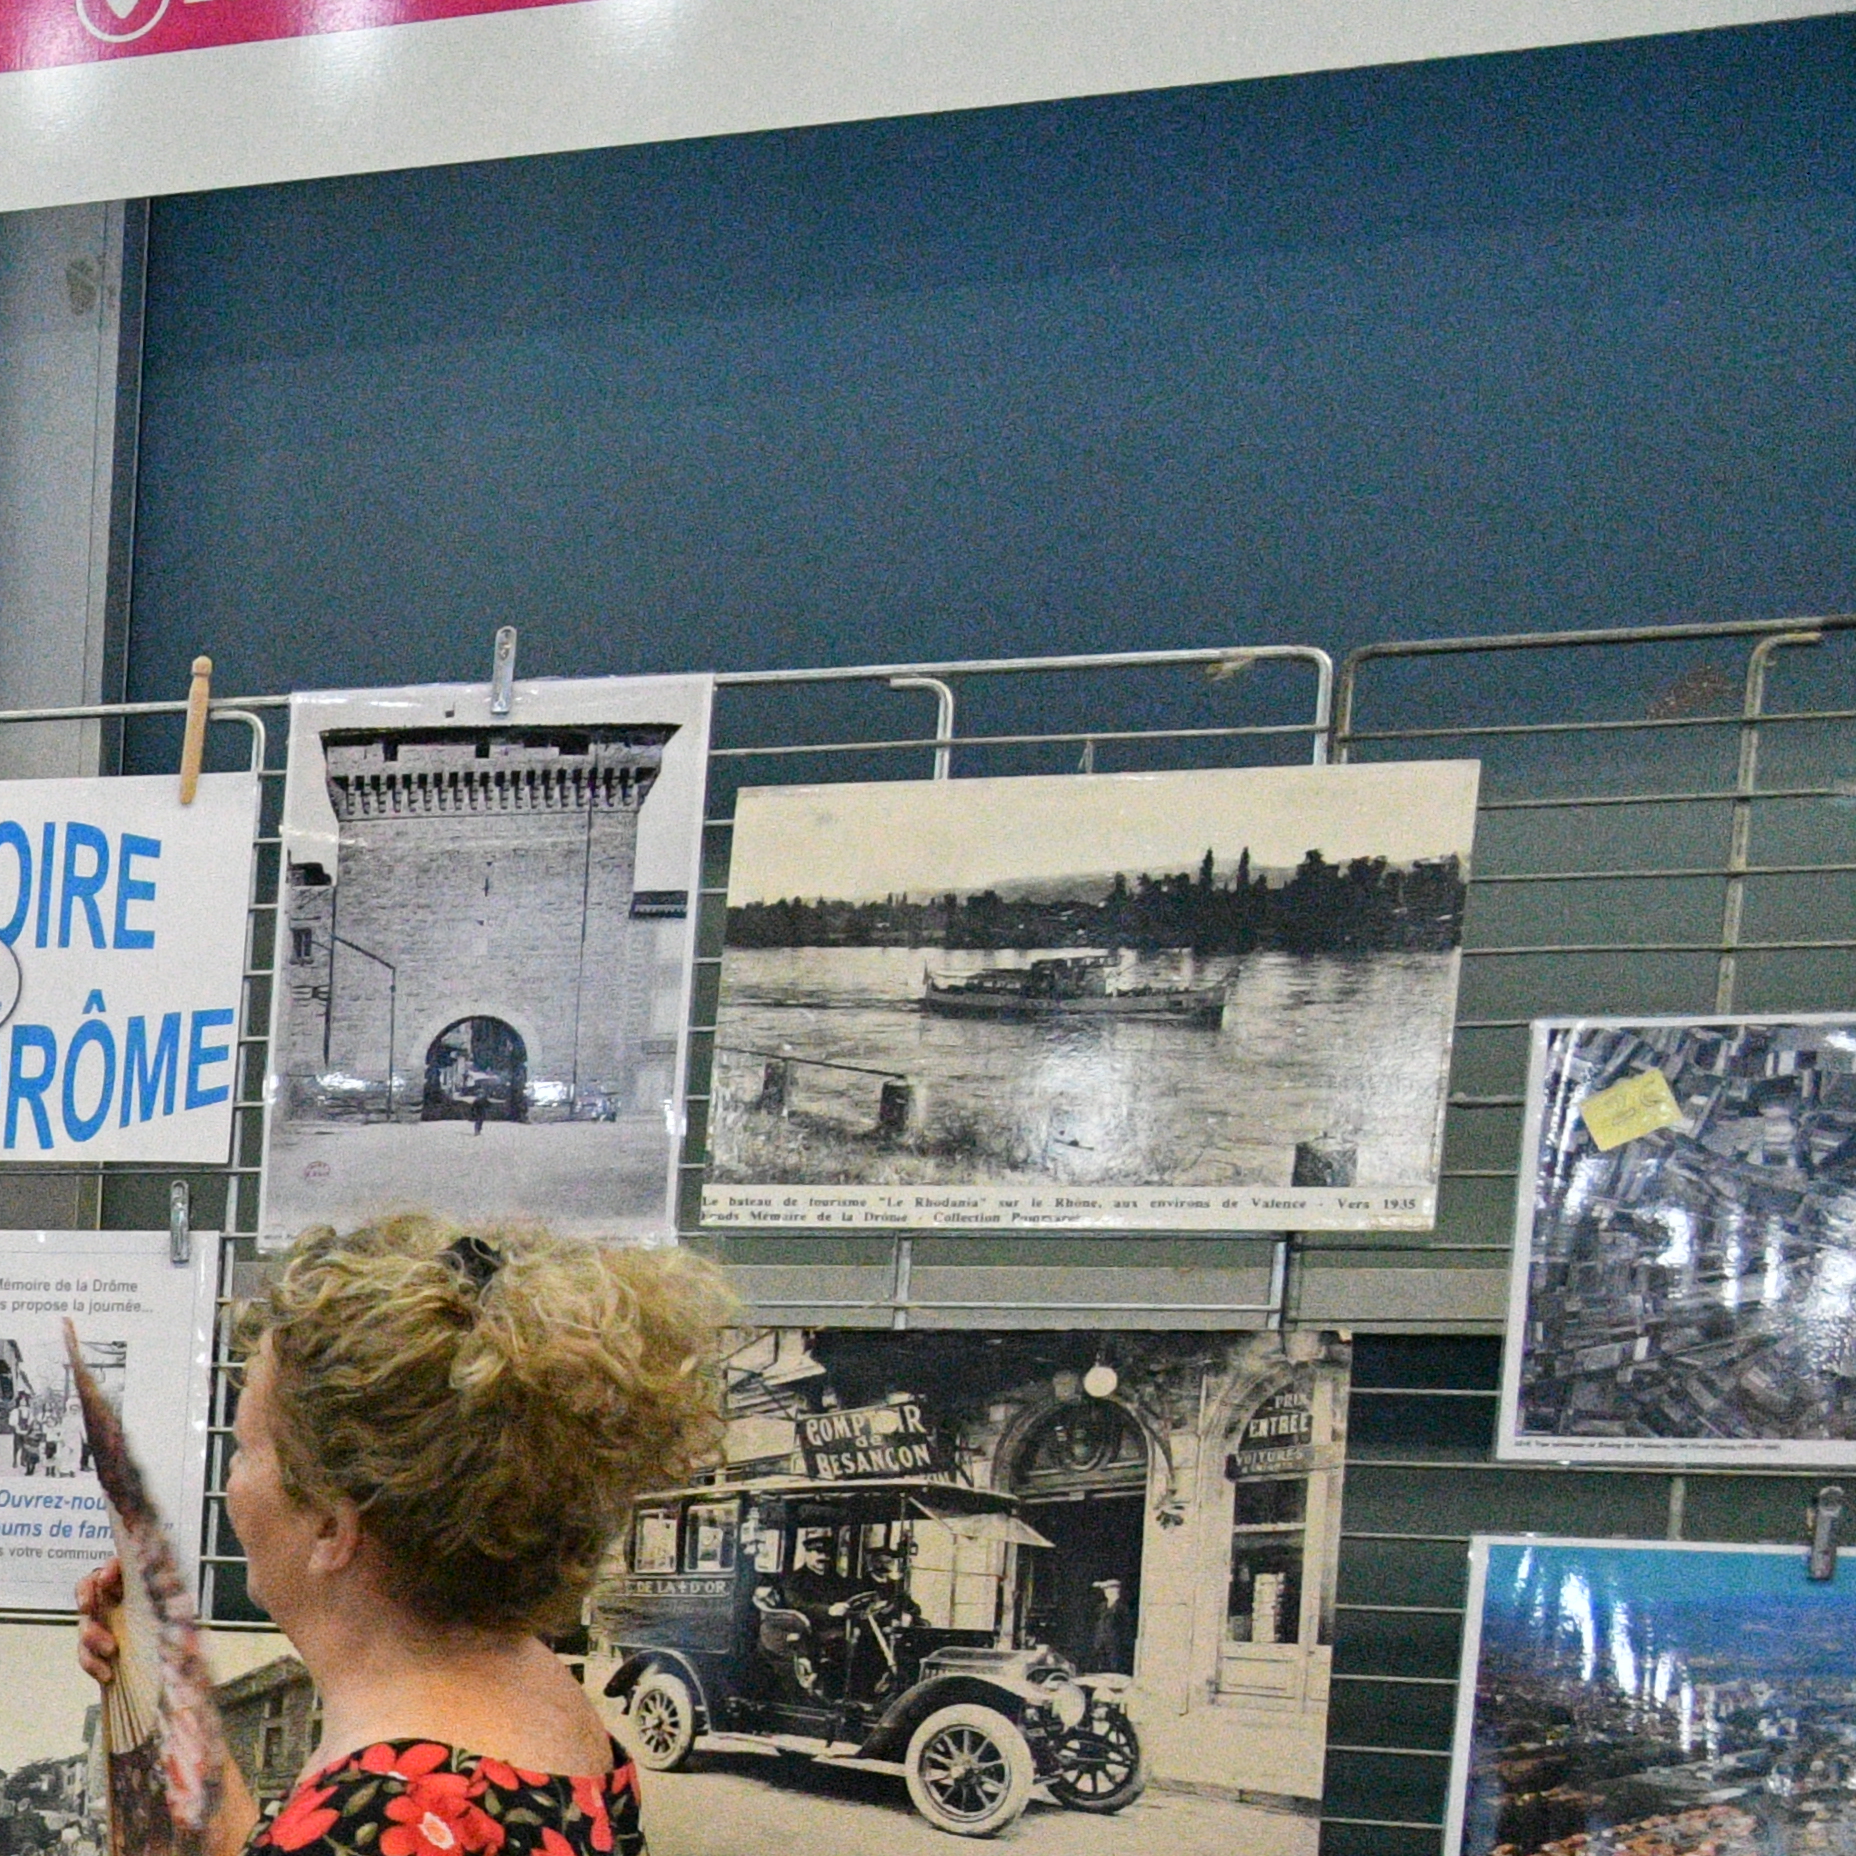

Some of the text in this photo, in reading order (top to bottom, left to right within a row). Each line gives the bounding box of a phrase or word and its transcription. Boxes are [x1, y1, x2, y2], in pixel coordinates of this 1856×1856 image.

[55, 1277, 71, 1292] de
[76, 1277, 88, 1292] la
[93, 1277, 138, 1293] Drôme
[12, 1300, 68, 1315] propose
[73, 1298, 84, 1312] la
[49, 1519, 72, 1537] de
[9, 1545, 43, 1558] votre
